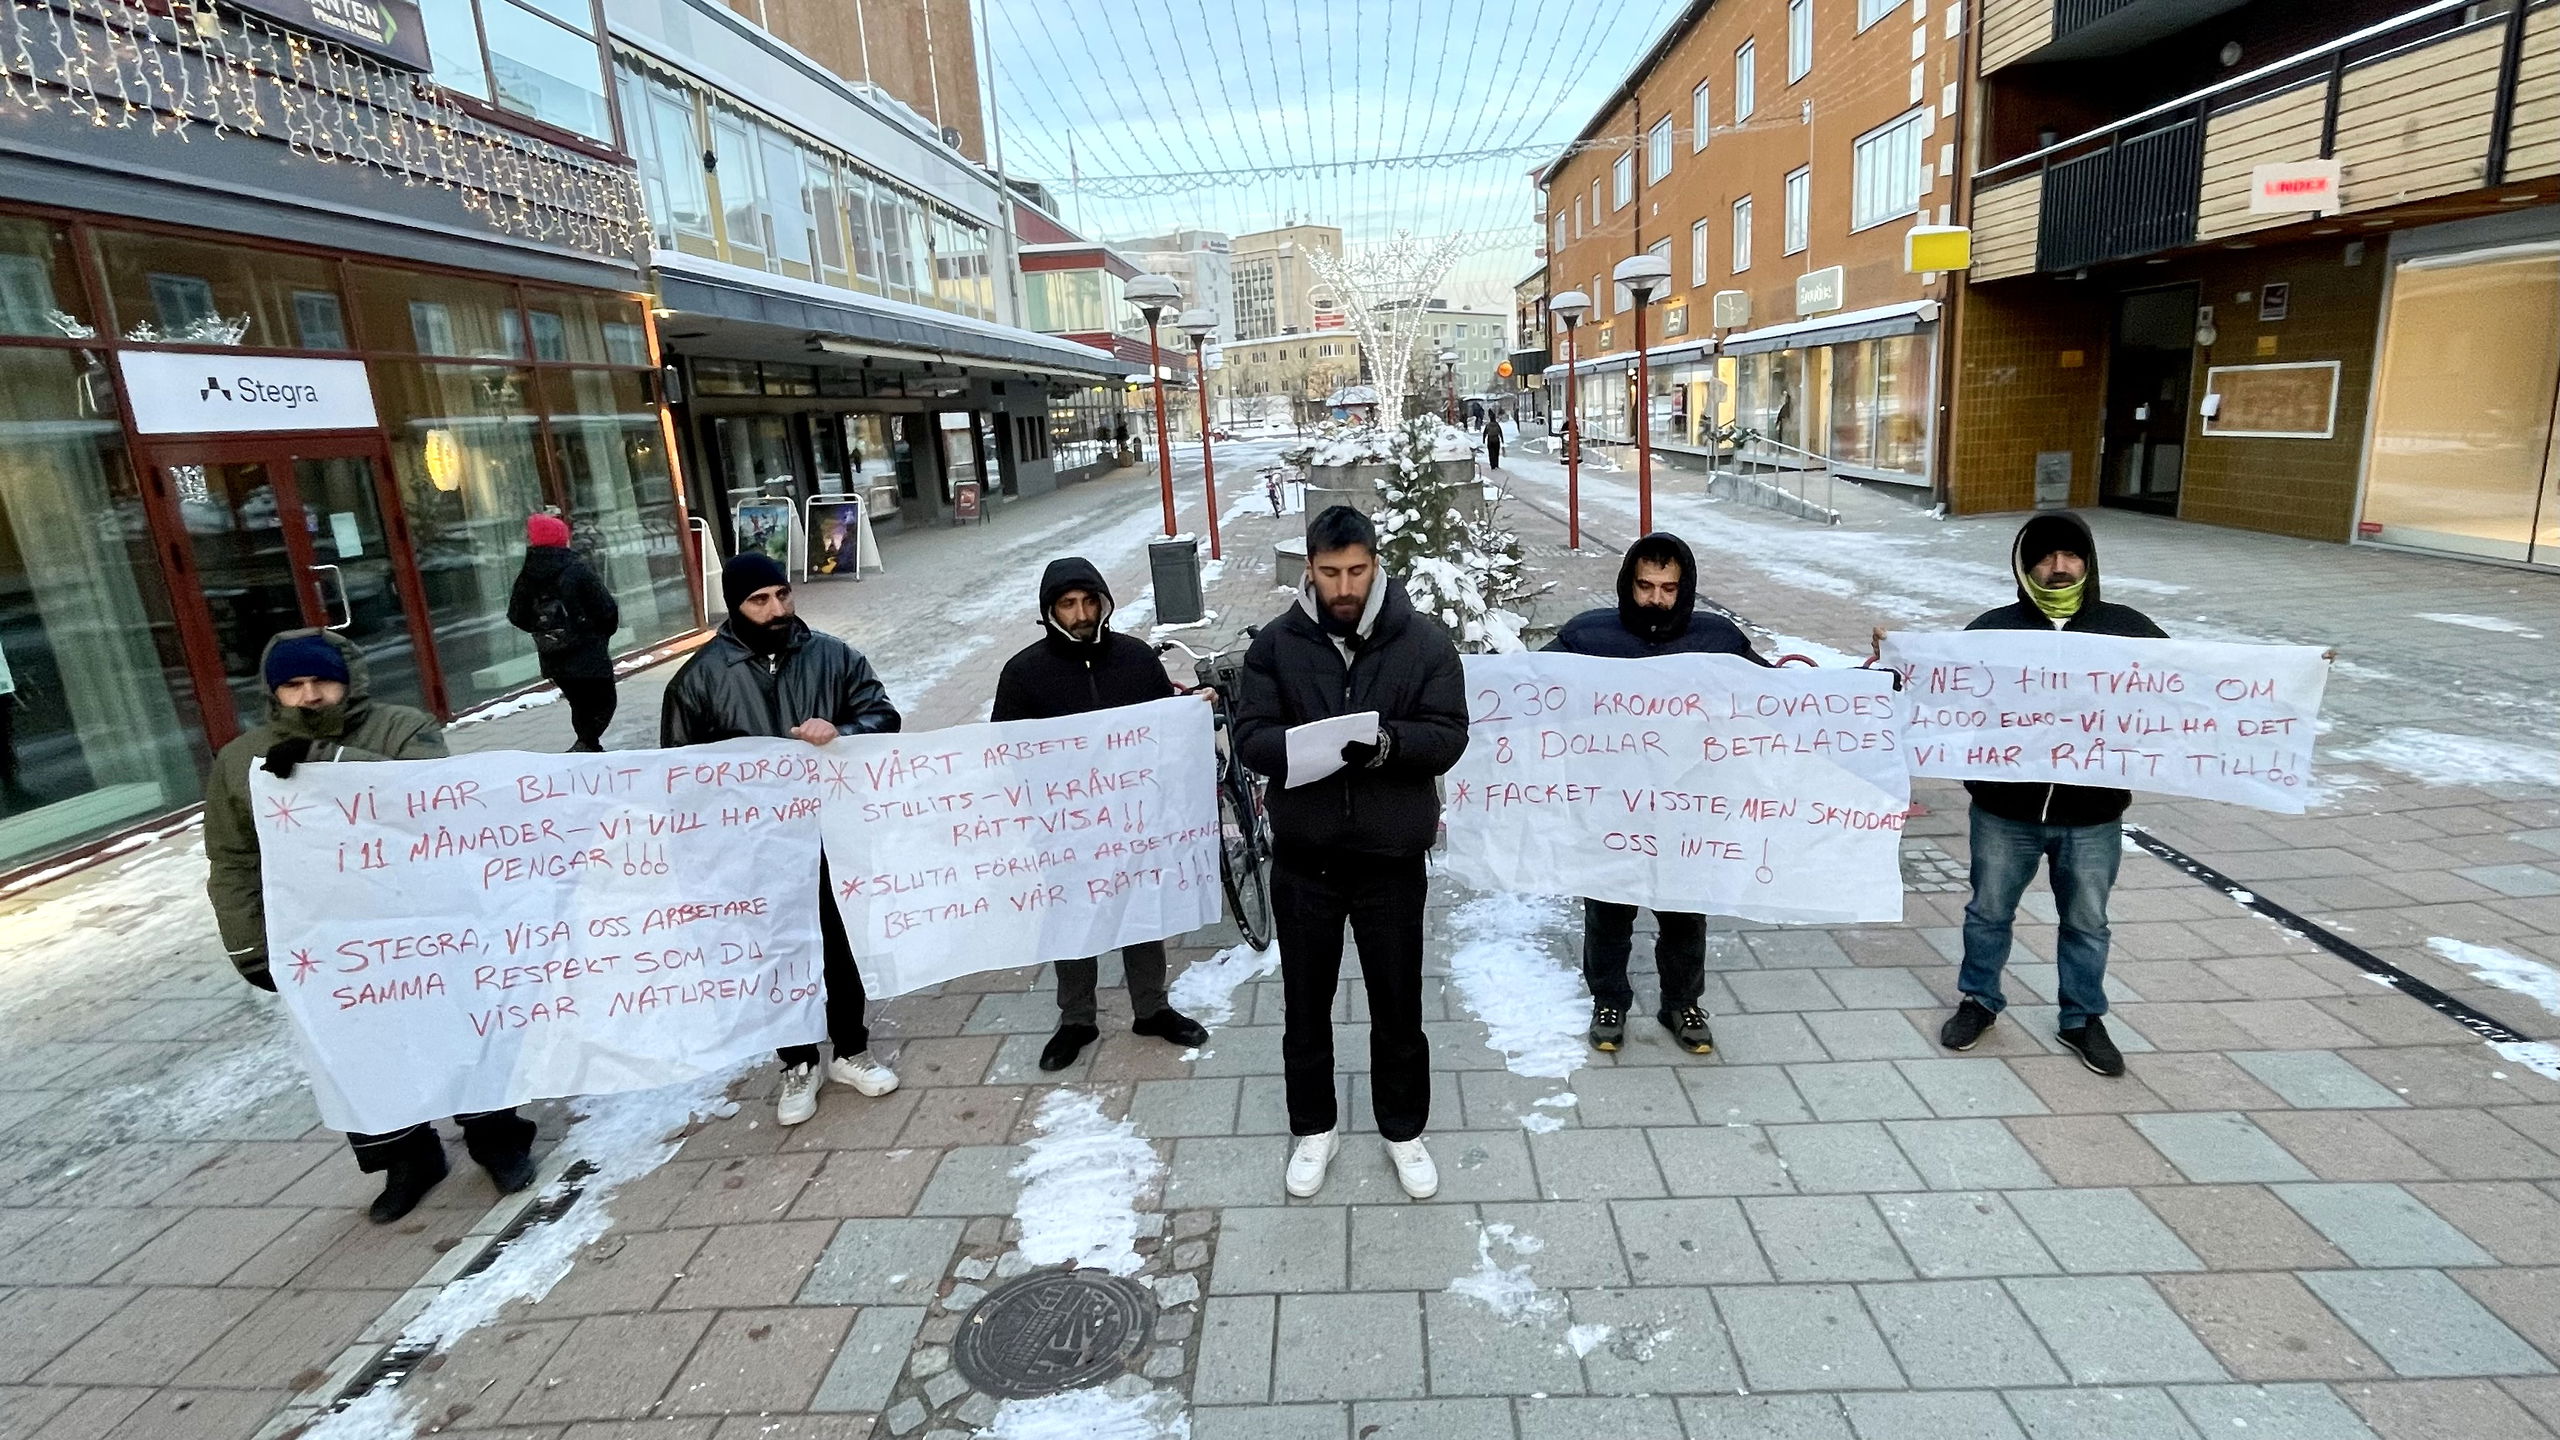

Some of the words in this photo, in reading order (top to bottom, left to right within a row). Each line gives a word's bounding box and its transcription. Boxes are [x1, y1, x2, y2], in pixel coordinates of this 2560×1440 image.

[238, 377, 318, 408] Stegra
[1930, 660, 1994, 699] NEJ
[2087, 662, 2184, 694] TVÅNG
[2215, 678, 2275, 702] OM
[1469, 683, 1567, 725] 230
[1593, 691, 1711, 723] KRONOR
[1728, 691, 1895, 721] LOVADES
[1911, 709, 1988, 729] 4000
[2183, 718, 2217, 735] HA
[2238, 718, 2297, 737] DET
[864, 749, 962, 792] VÅRT
[983, 735, 1089, 769] ARBETE
[1106, 725, 1159, 750] HAR
[1496, 736, 1513, 764] 8
[1541, 730, 1670, 761] DOLLAR
[1702, 729, 1896, 763] BETALADES
[1967, 745, 2023, 767] HAR
[407, 781, 487, 818] HAR
[1485, 783, 1602, 812] FACKET
[1741, 799, 1797, 823] MEN
[1808, 802, 1907, 831] SKYDDAD
[361, 838, 390, 870] 11
[722, 807, 760, 826] HA
[1603, 831, 1658, 858] OSS
[870, 865, 957, 898] SLUTA
[974, 847, 1076, 881] FÖRHALA
[883, 896, 990, 940] BETALA
[1010, 883, 1067, 911] VÅR
[336, 928, 489, 973] STEGRA,
[589, 916, 631, 937] OSS
[642, 897, 768, 935] ARBETARE
[332, 972, 446, 1010] SAMMA
[474, 955, 621, 991] RESPEKT
[634, 947, 705, 973] SOM
[720, 941, 763, 965] DU
